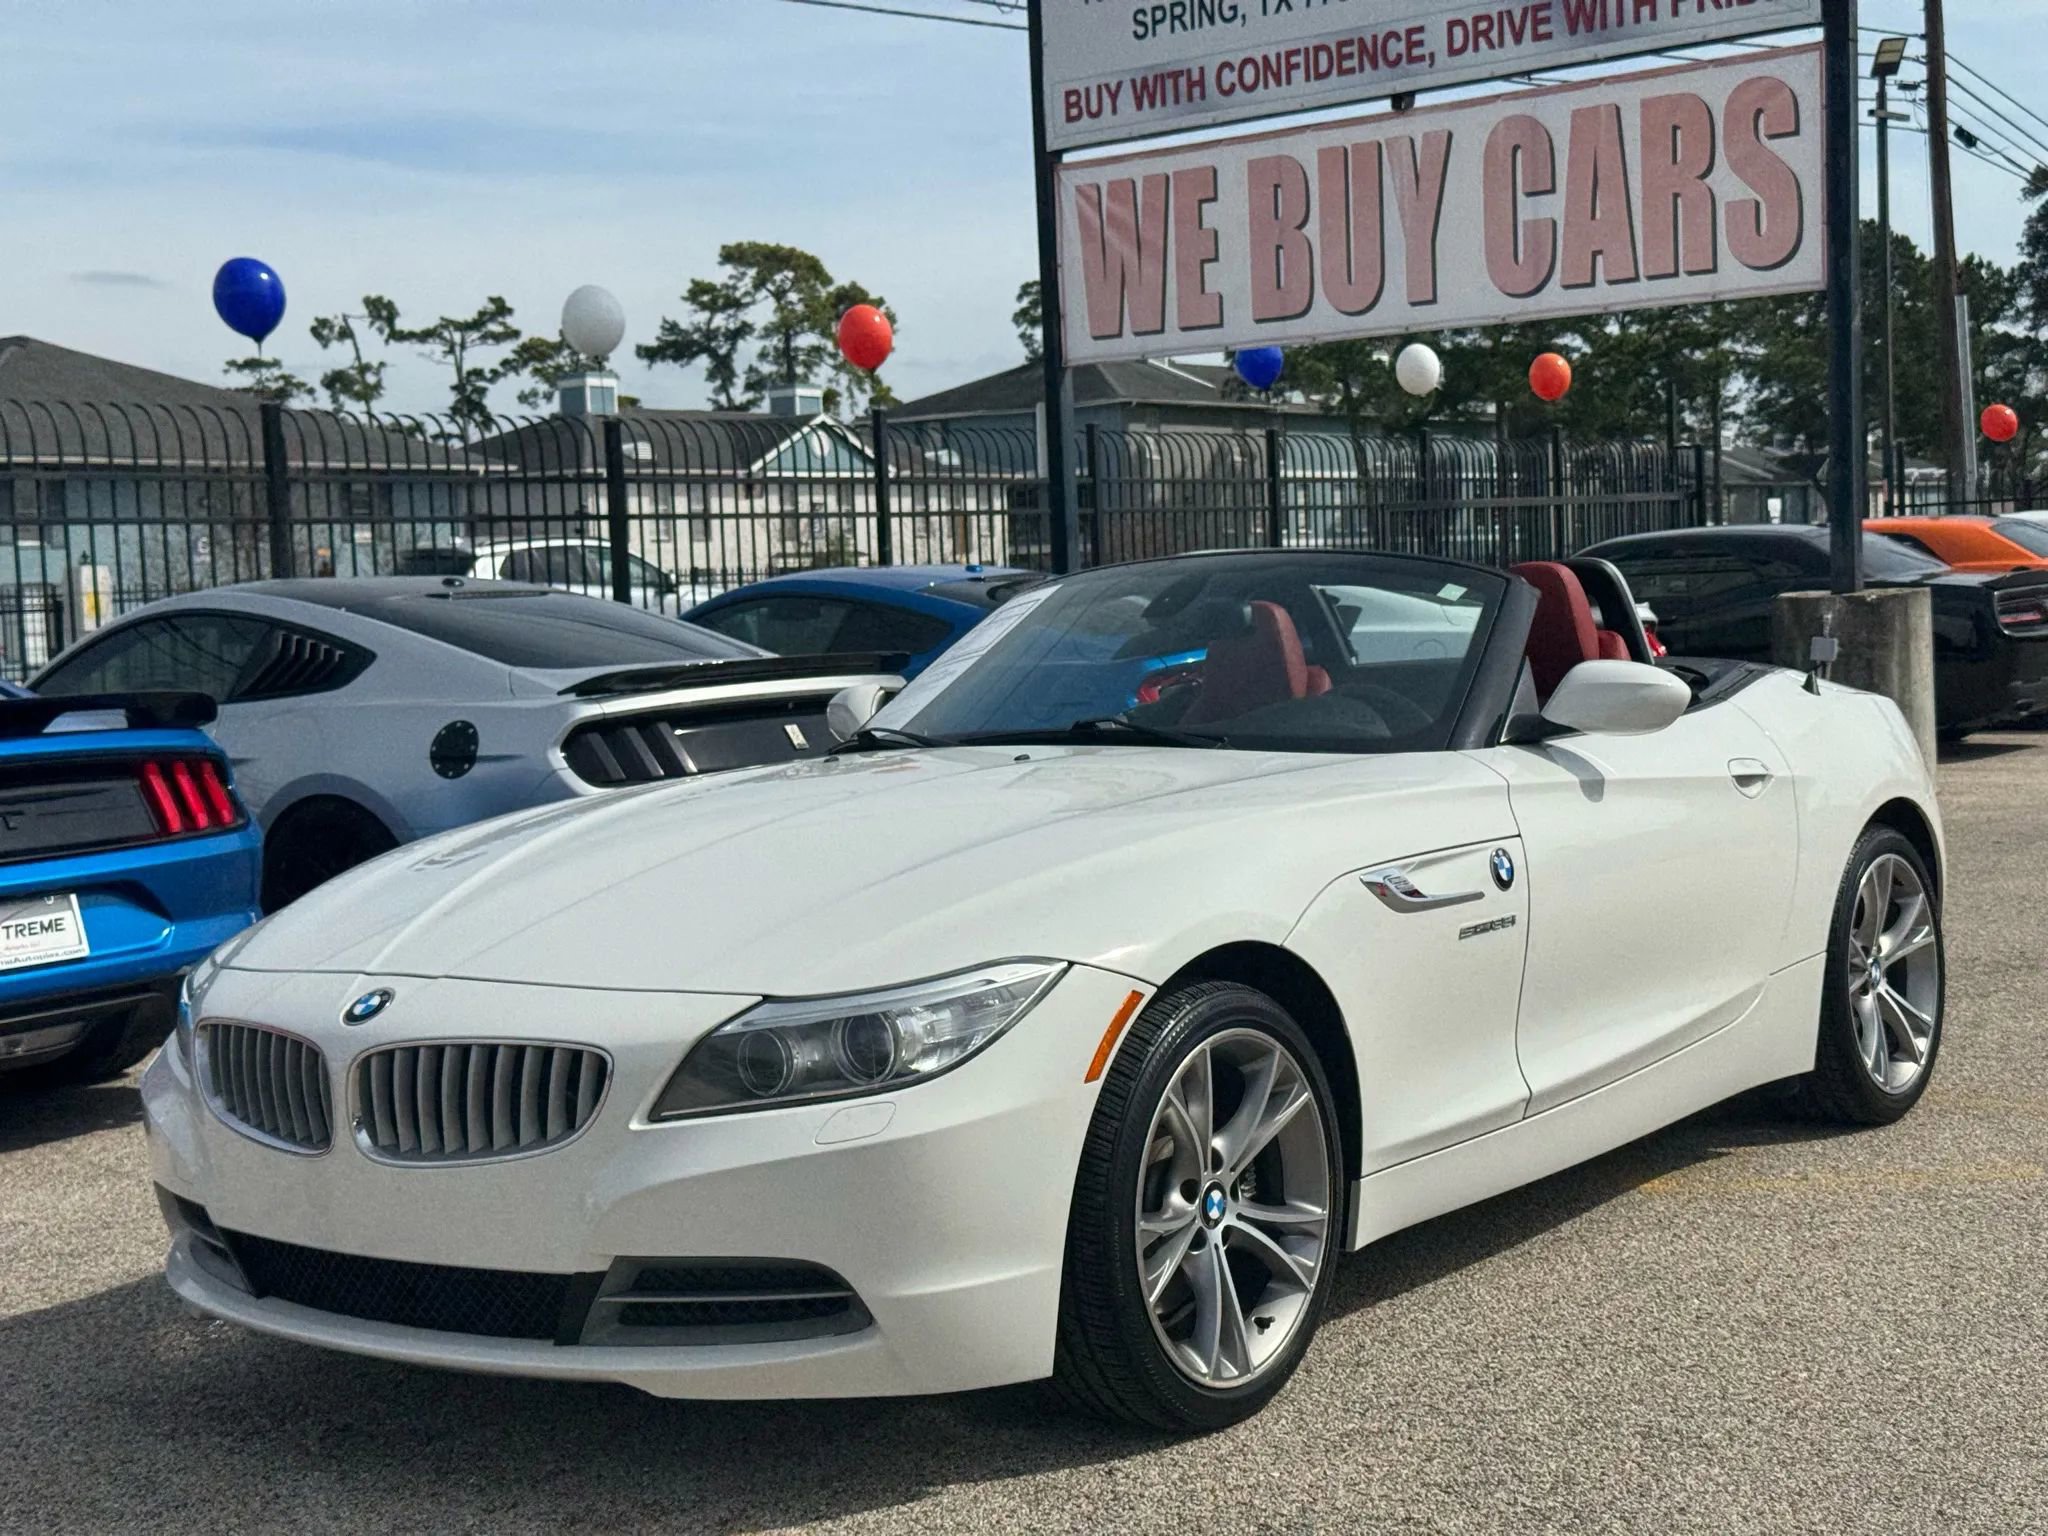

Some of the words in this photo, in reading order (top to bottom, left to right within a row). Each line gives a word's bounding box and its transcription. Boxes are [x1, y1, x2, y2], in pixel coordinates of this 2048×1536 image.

[1064, 80, 1125, 123] BUY
[1130, 66, 1207, 112] WITH
[1215, 25, 1437, 97] CONFIDENCE,
[1446, 1, 1553, 58] DRIVE
[1564, 0, 1658, 35] WITH
[1132, 0, 1247, 41] SPRING,
[1075, 165, 1223, 339] WE
[1246, 130, 1452, 322] BUY
[1483, 76, 1801, 298] CARS
